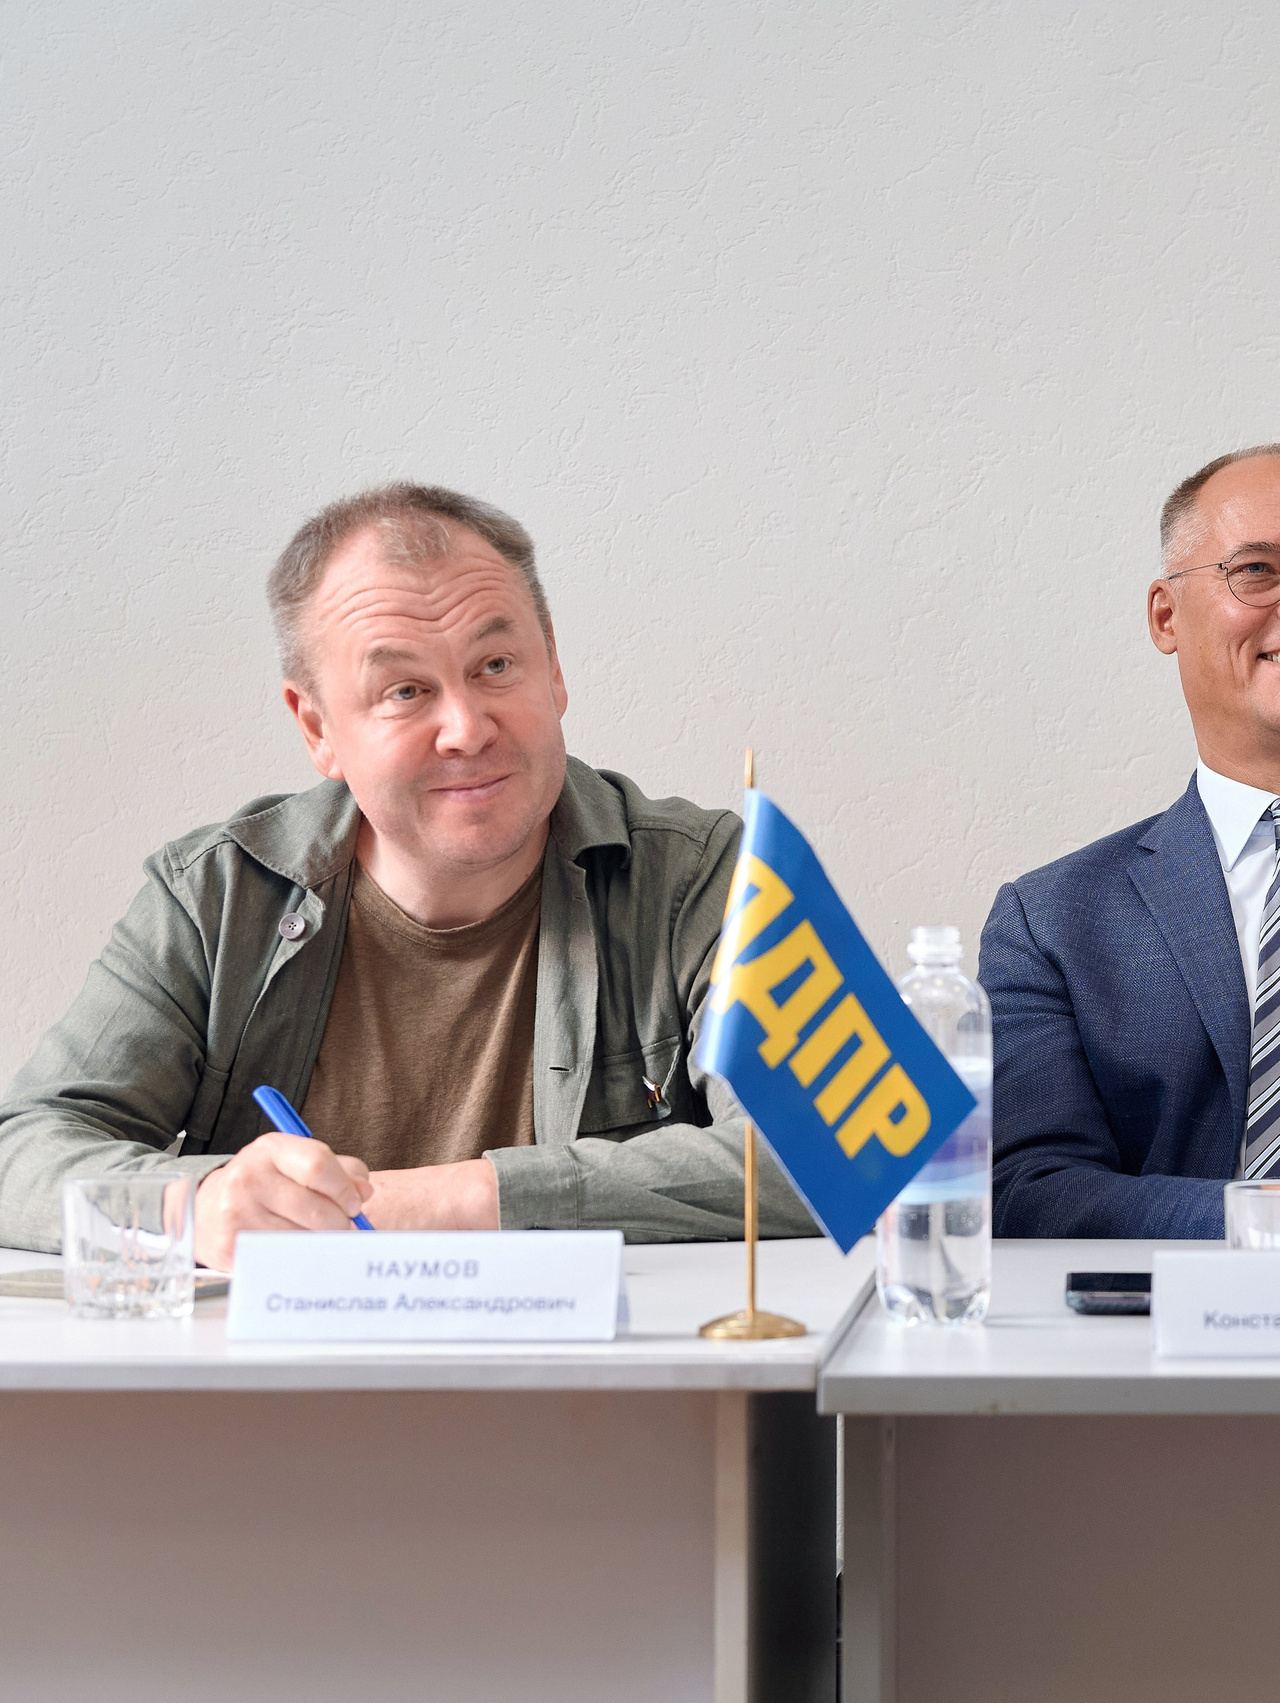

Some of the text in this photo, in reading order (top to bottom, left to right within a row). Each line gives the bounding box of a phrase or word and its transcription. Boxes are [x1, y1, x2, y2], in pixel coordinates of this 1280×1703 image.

[709, 851, 932, 1159] ЛДПР
[366, 1260, 480, 1280] НАУМОВ
[265, 1292, 577, 1315] Станислав Александрович
